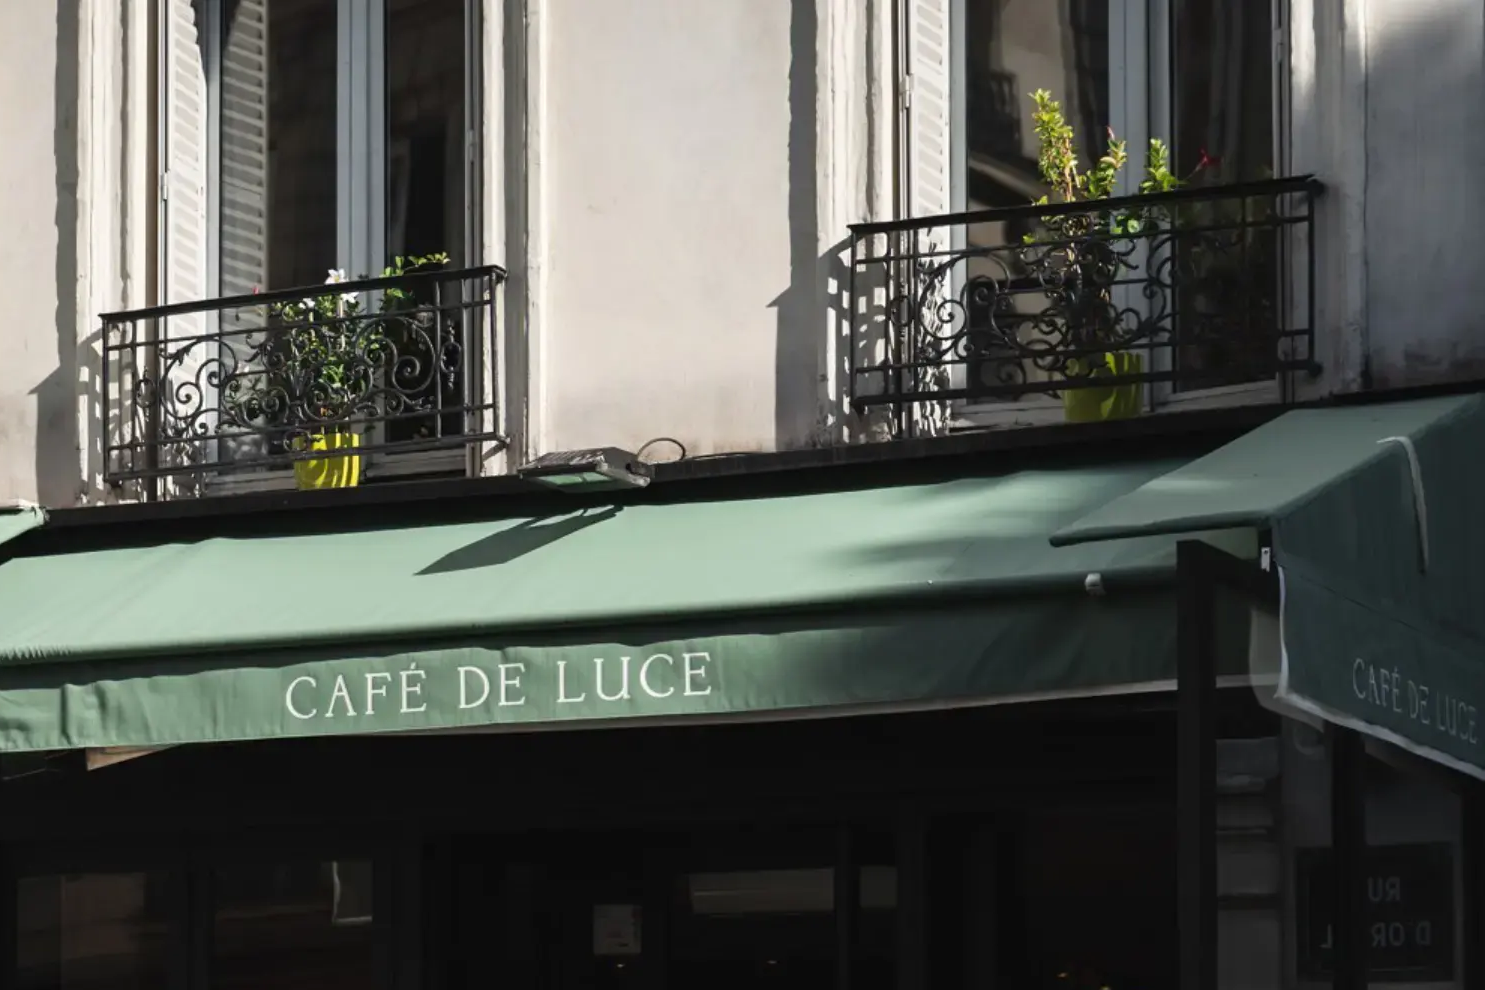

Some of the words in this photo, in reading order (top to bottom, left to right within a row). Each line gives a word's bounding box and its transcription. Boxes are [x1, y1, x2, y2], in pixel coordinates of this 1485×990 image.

[285, 659, 427, 720] CAFÉ
[457, 662, 526, 709] DE
[552, 650, 712, 704] LUCE
[1352, 657, 1403, 713] CAFÉ
[1407, 680, 1431, 725] DE
[1436, 692, 1478, 745] LUCE
